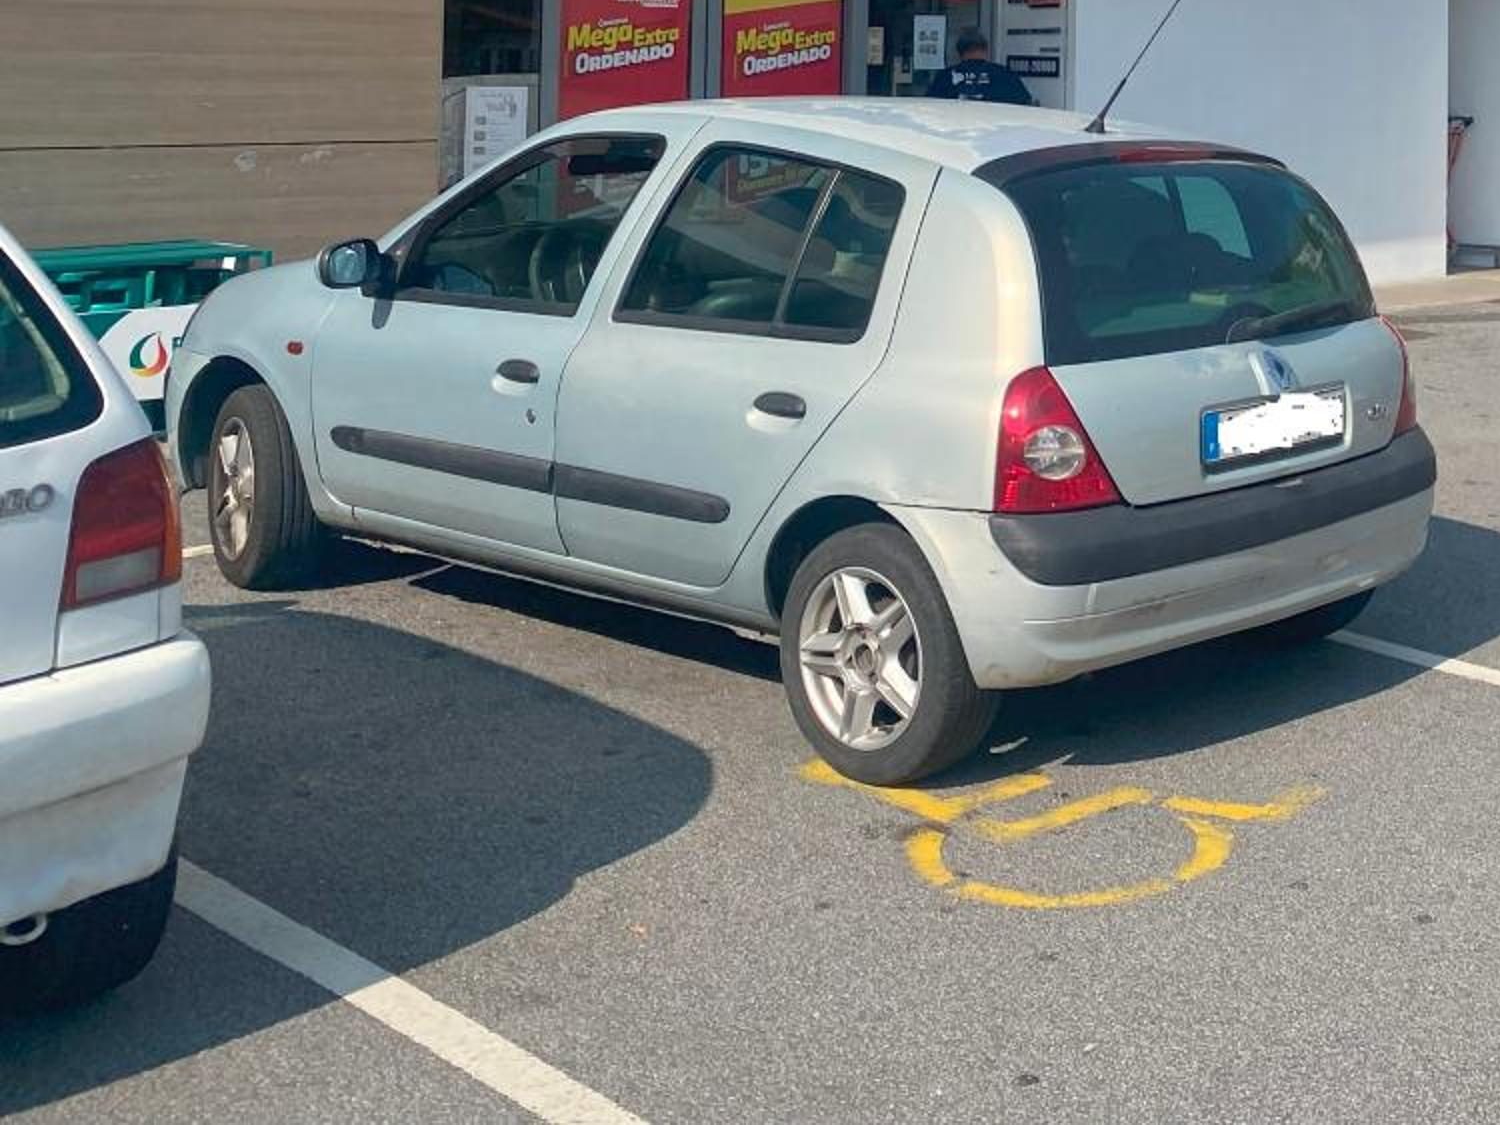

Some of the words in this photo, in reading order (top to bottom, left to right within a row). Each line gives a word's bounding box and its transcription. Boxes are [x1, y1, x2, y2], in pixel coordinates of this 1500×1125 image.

[568, 25, 633, 52] Mega
[633, 27, 679, 46] Extra
[736, 28, 794, 55] Mega
[795, 31, 835, 49] Extra
[575, 43, 674, 74] ORDENADO
[743, 45, 831, 75] ORDENADO
